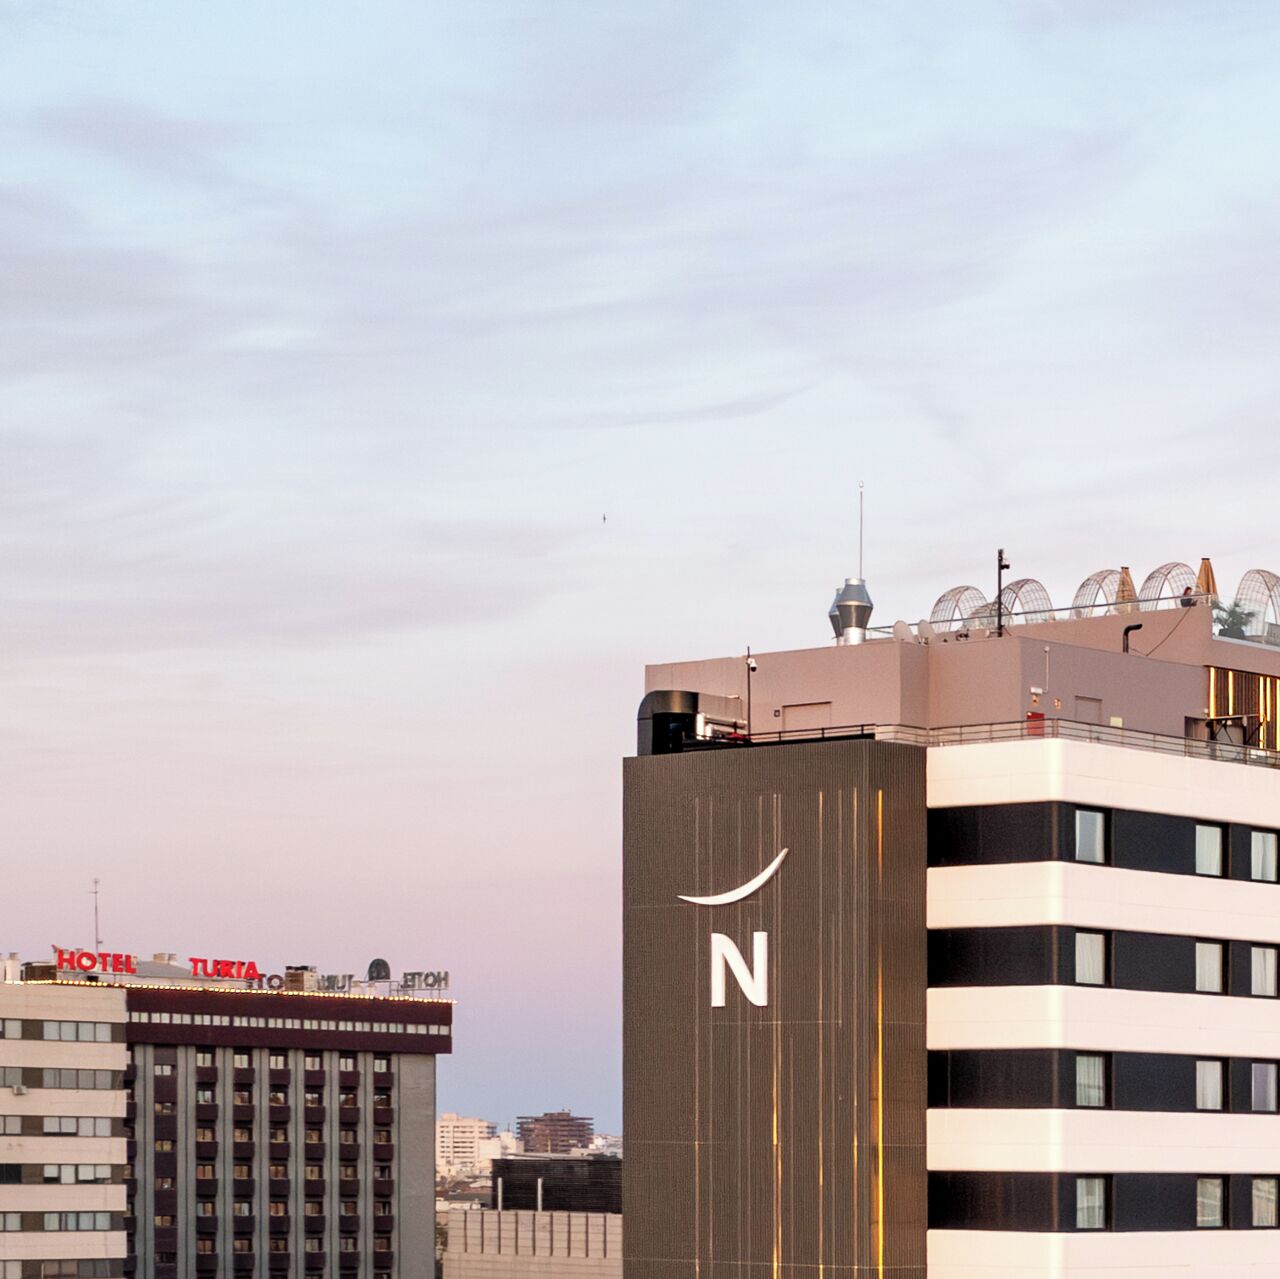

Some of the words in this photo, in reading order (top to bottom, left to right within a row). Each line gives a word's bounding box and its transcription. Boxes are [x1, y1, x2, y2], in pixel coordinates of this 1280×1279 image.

[56, 948, 137, 974] HOTEL
[188, 957, 261, 981] TURIA
[711, 931, 768, 1008] N
